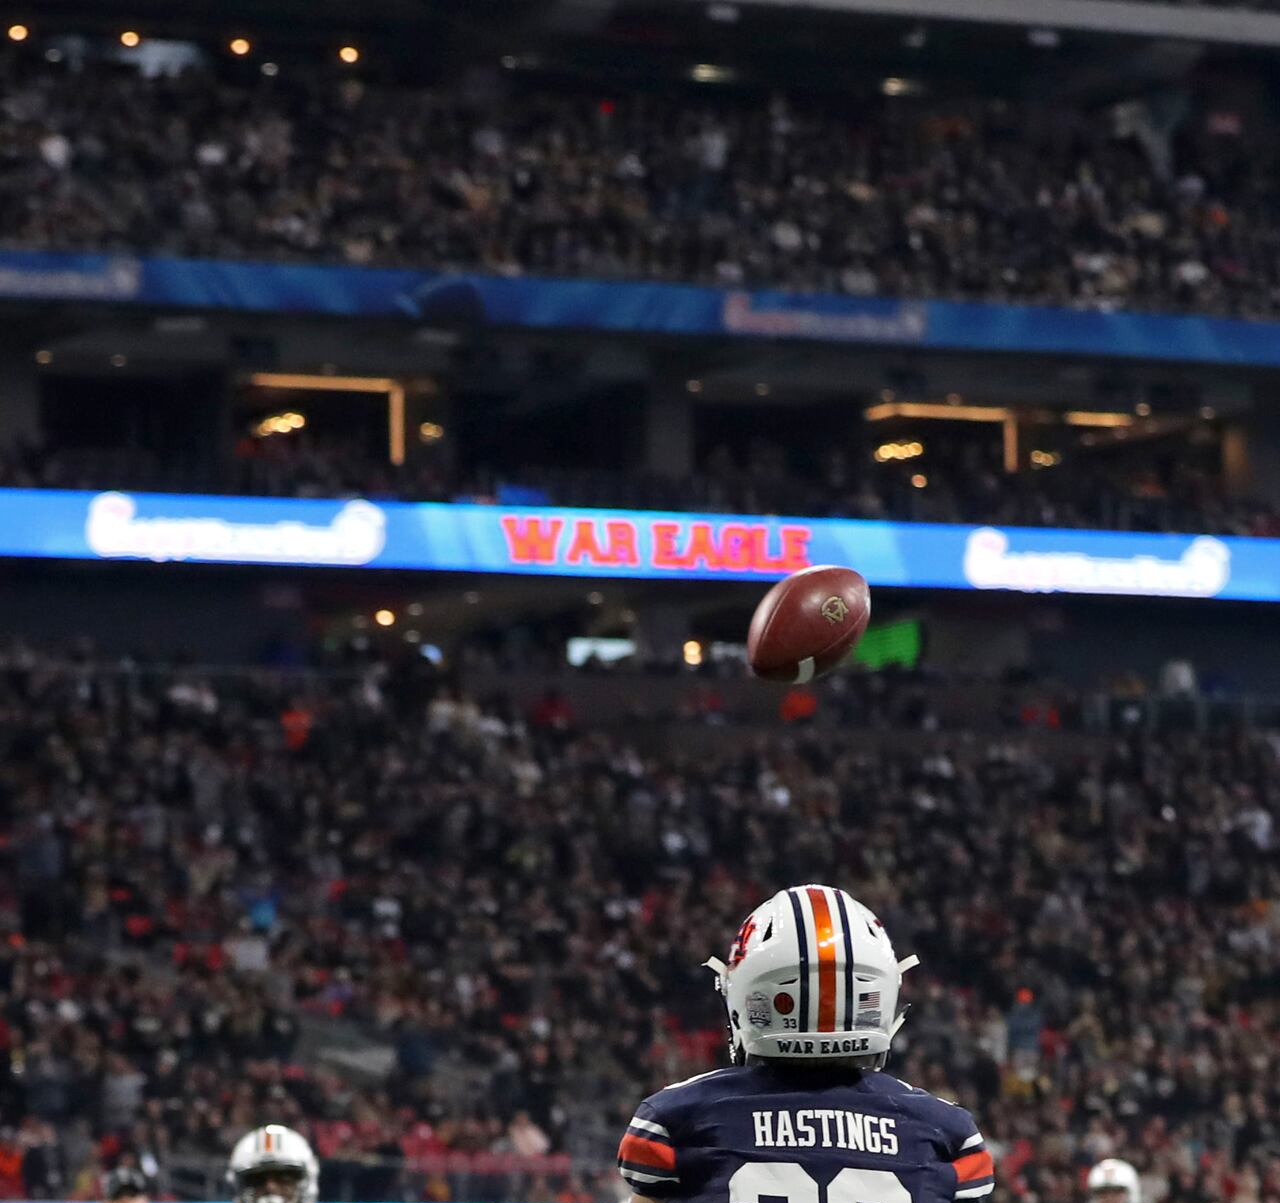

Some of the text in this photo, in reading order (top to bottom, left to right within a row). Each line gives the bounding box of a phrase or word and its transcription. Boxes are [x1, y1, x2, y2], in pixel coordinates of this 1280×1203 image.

[501, 516, 812, 574] WAR EAGLE
[783, 1018, 798, 1029] 33
[777, 1038, 870, 1054] WAR EAGLE
[752, 1109, 899, 1155] HASTINGS
